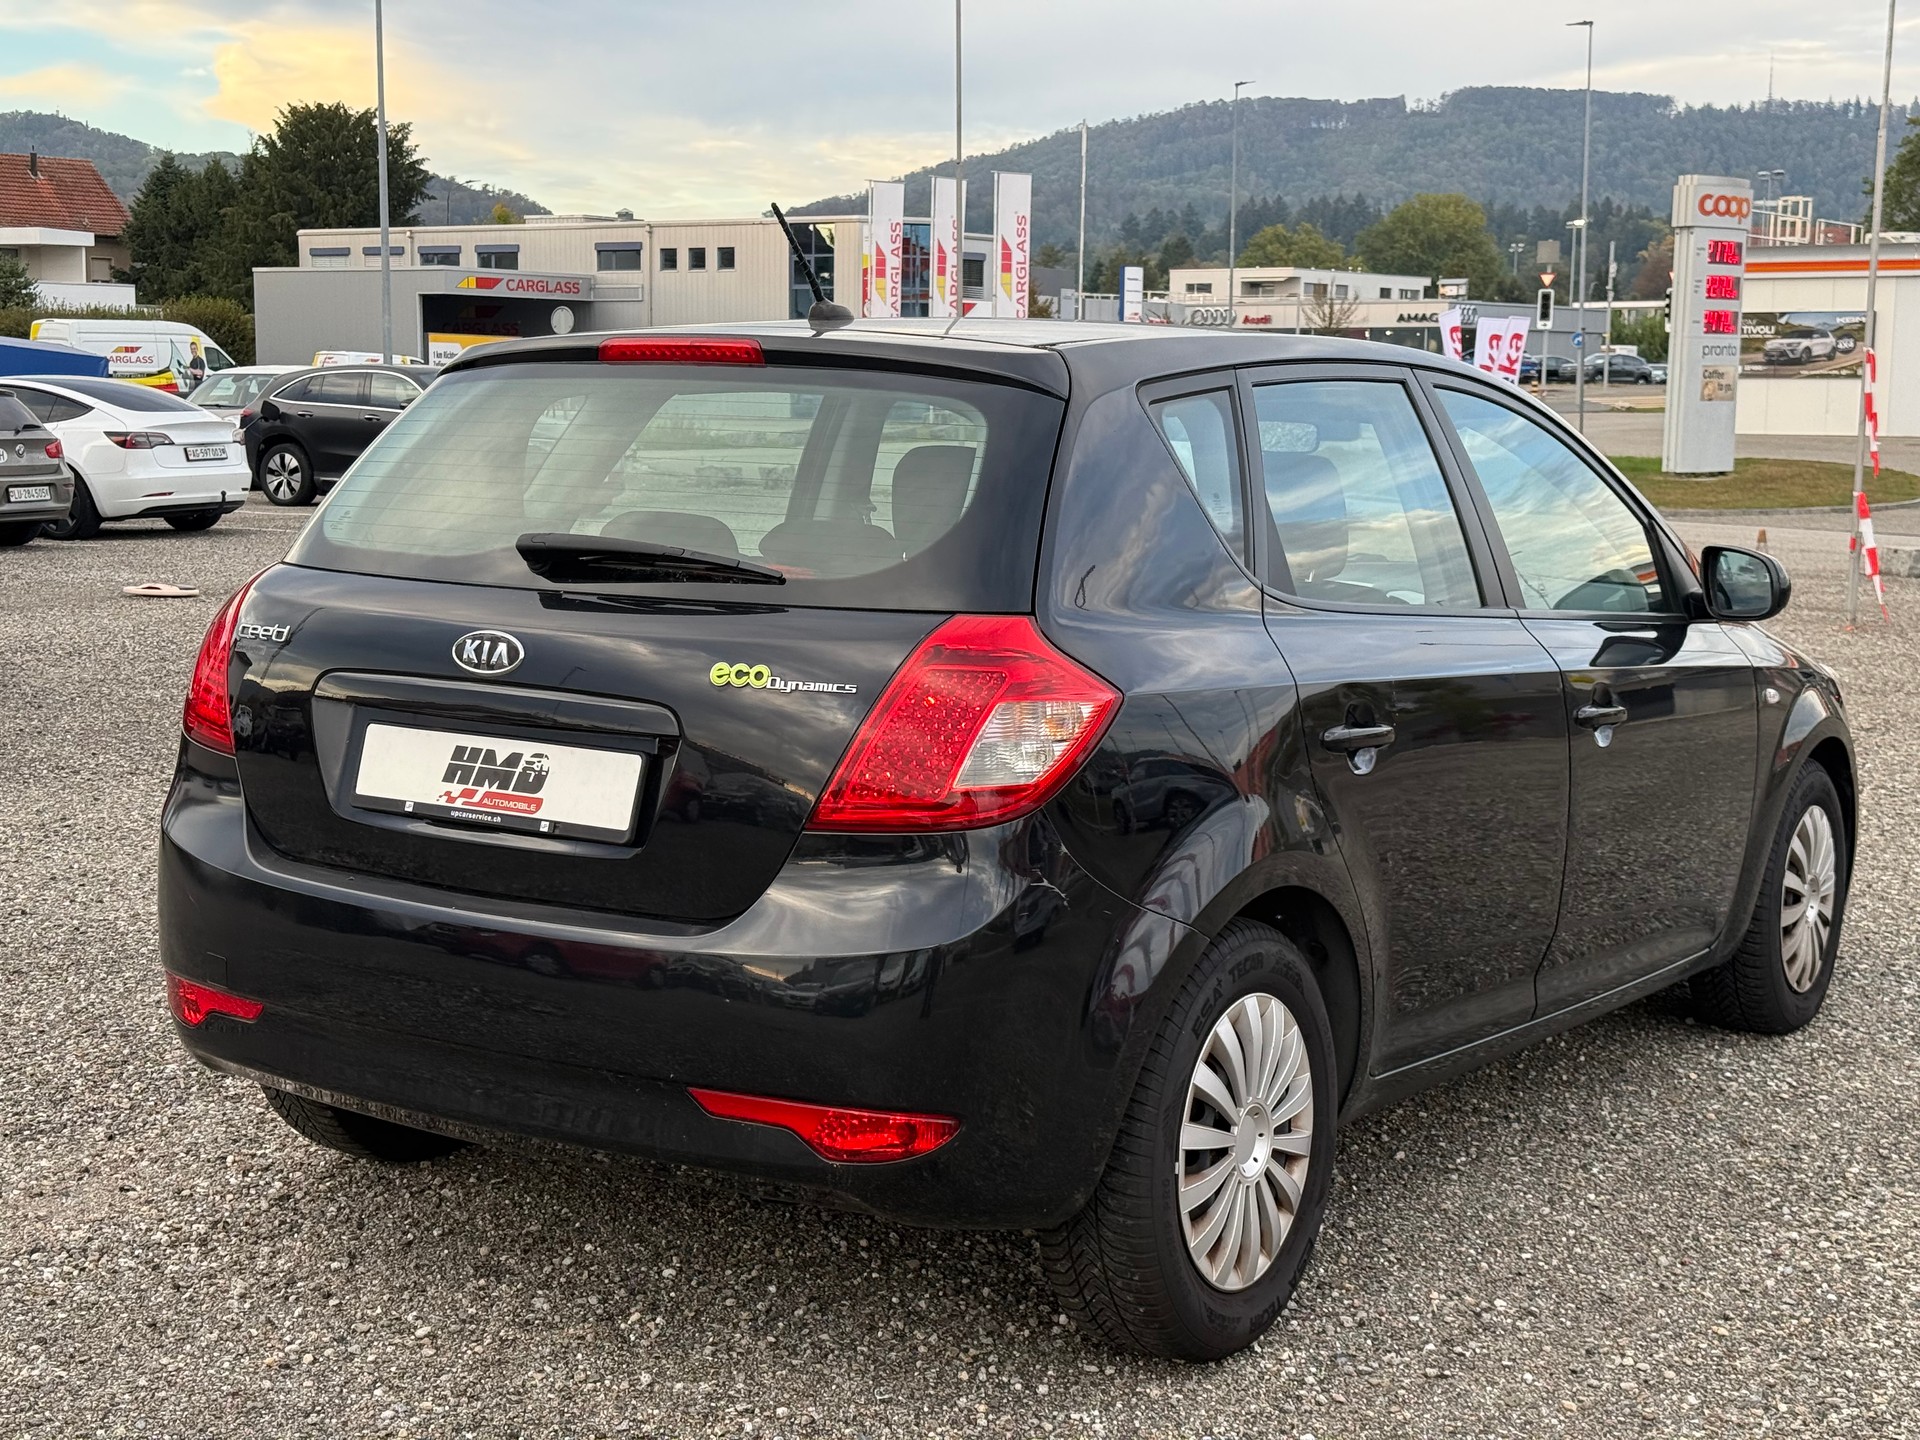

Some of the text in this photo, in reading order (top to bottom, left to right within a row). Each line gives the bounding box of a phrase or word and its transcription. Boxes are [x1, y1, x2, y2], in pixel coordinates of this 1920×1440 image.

[1698, 193, 1751, 225] coop
[1016, 214, 1027, 319] CARGLASS
[506, 278, 581, 295] CARGLASS
[1396, 312, 1439, 324] AMAG
[1741, 325, 1776, 335] TIVOLI
[109, 355, 154, 364] ARGLASS
[1701, 343, 1738, 360] pronto
[462, 638, 510, 656] KIA
[709, 661, 858, 694] eco Dynamics
[481, 797, 538, 812] AUTOMOBILE
[450, 809, 502, 823] upcarservice.ch
